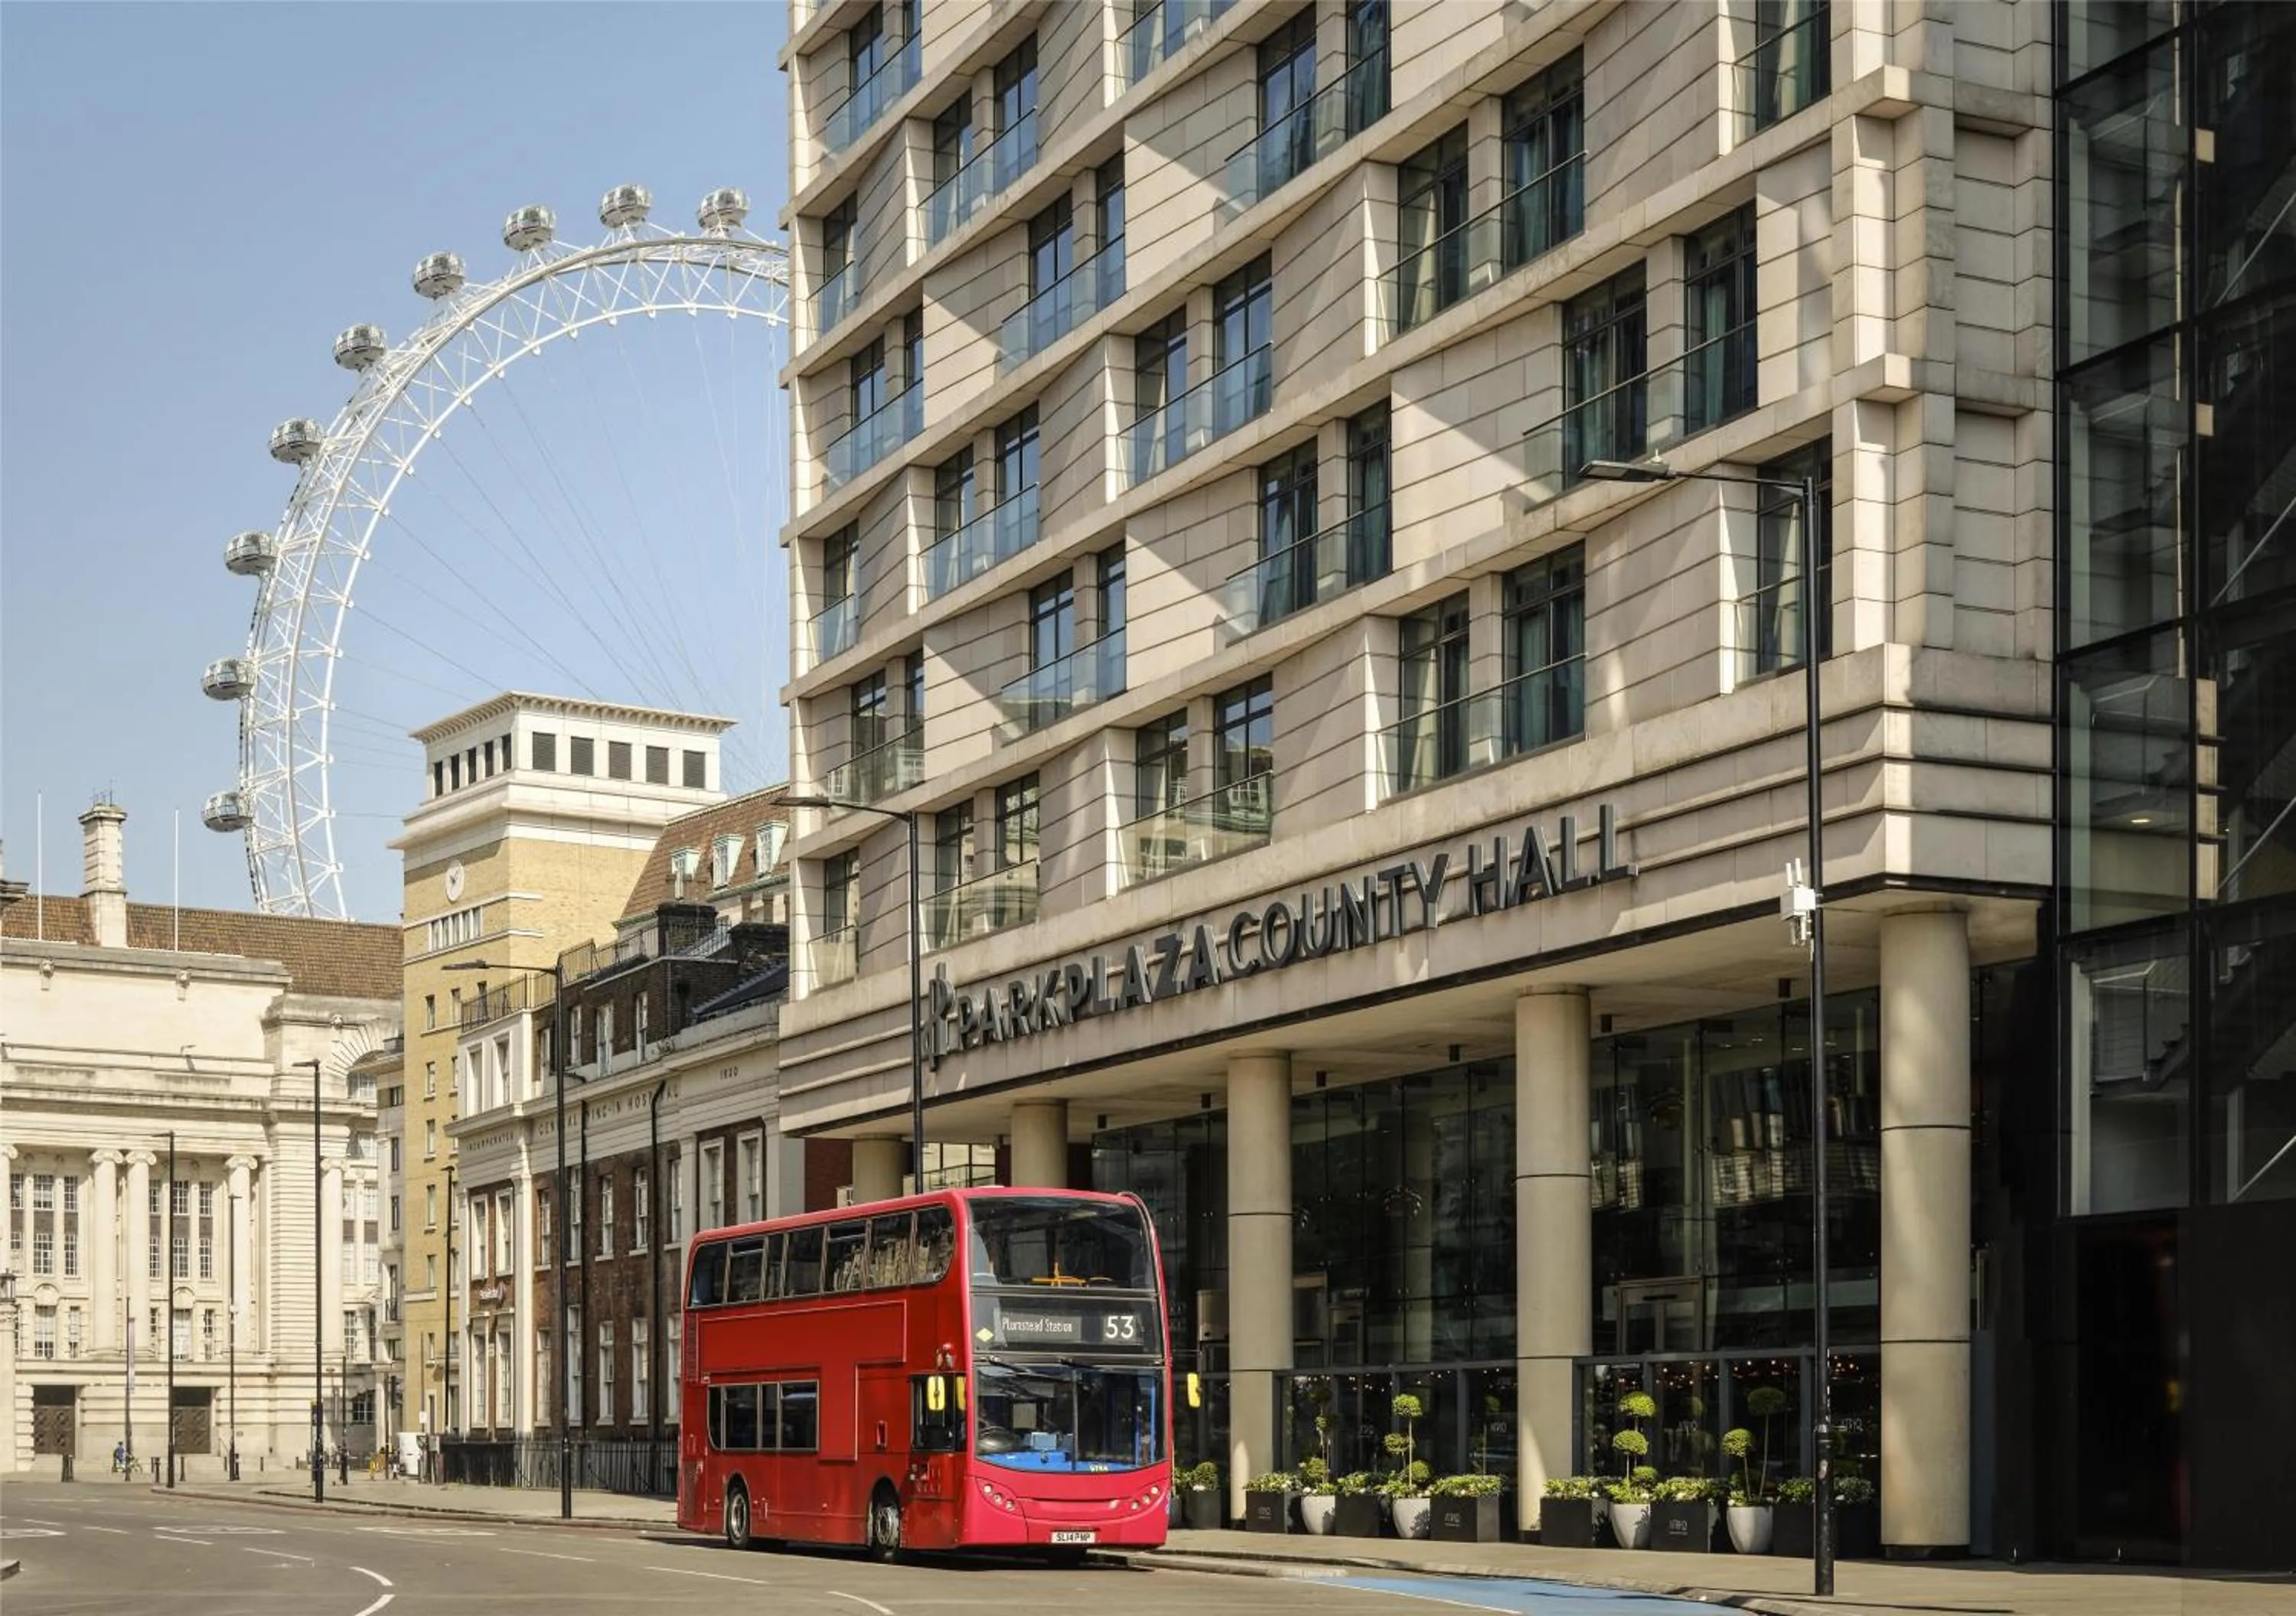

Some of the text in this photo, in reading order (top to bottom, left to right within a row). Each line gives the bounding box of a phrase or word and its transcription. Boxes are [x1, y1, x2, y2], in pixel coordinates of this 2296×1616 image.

[1227, 852, 1450, 977] COUNTY
[1468, 803, 1639, 917] HALL
[1002, 1317, 1072, 1332] Plumstead Station
[1106, 1315, 1134, 1338] 53
